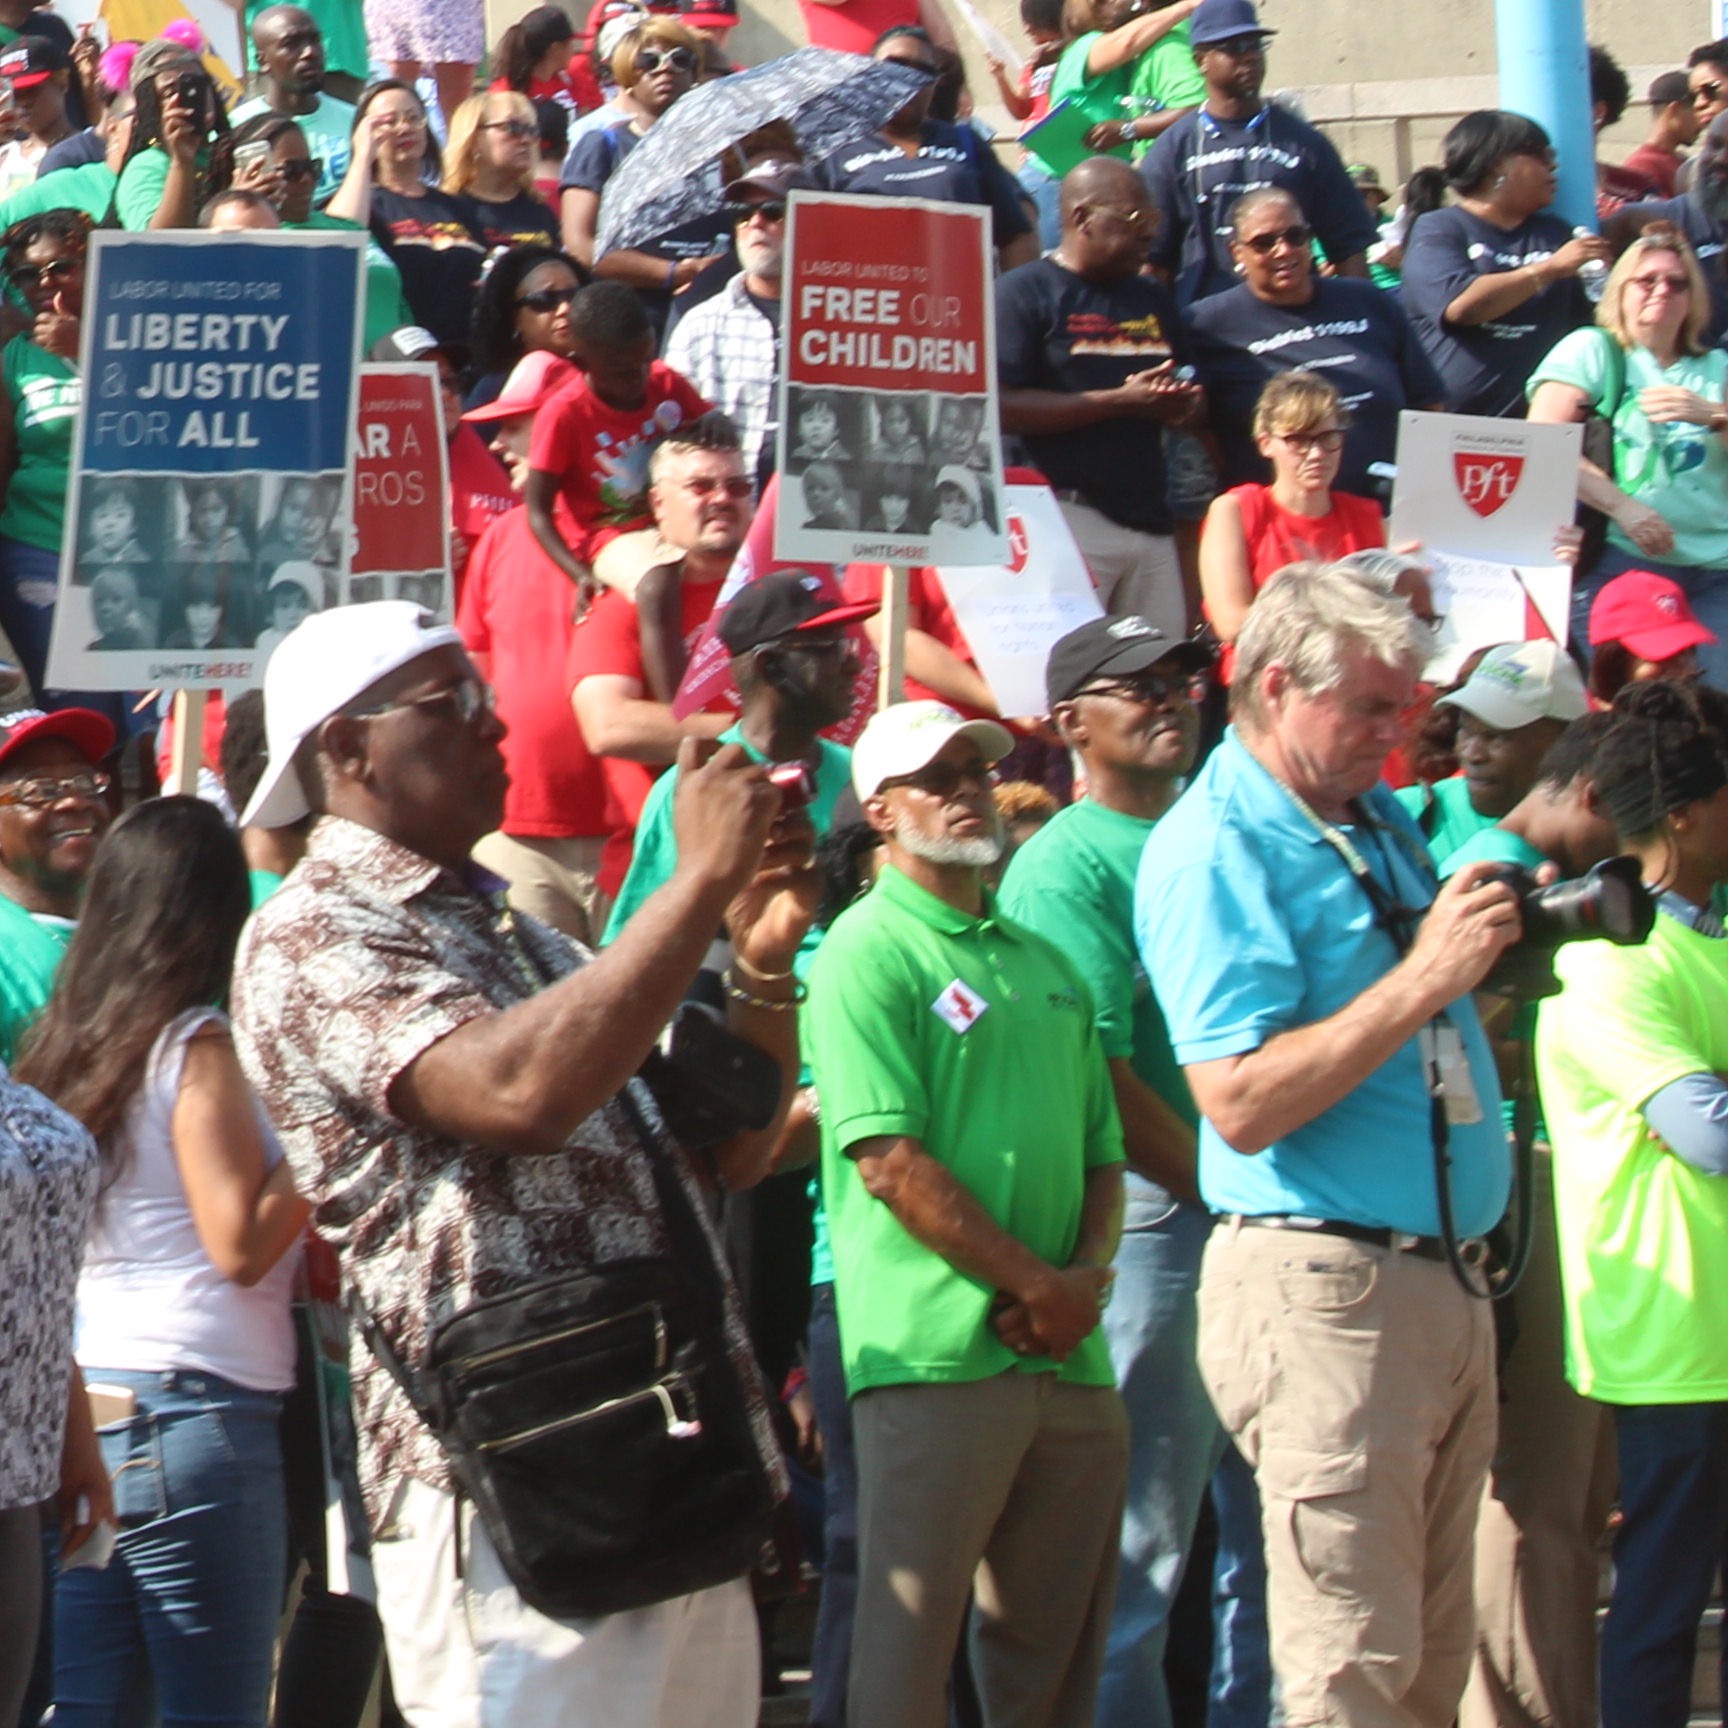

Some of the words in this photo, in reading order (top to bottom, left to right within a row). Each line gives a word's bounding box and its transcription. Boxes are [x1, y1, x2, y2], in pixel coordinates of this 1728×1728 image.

[800, 259, 852, 276] LABOR
[854, 263, 911, 281] UNITED
[912, 267, 930, 282] TO
[108, 281, 169, 301] LABOR
[171, 281, 240, 301] UNITED
[244, 280, 282, 300] FOR
[800, 285, 901, 326] FREE
[909, 293, 962, 327] OUR
[103, 313, 290, 352] LIBERTY
[799, 330, 977, 376] CHILDREN
[100, 362, 127, 399] &
[136, 362, 321, 401] JUSTICE
[94, 410, 170, 448] FOR
[176, 410, 261, 449] ALL
[400, 424, 422, 457] A
